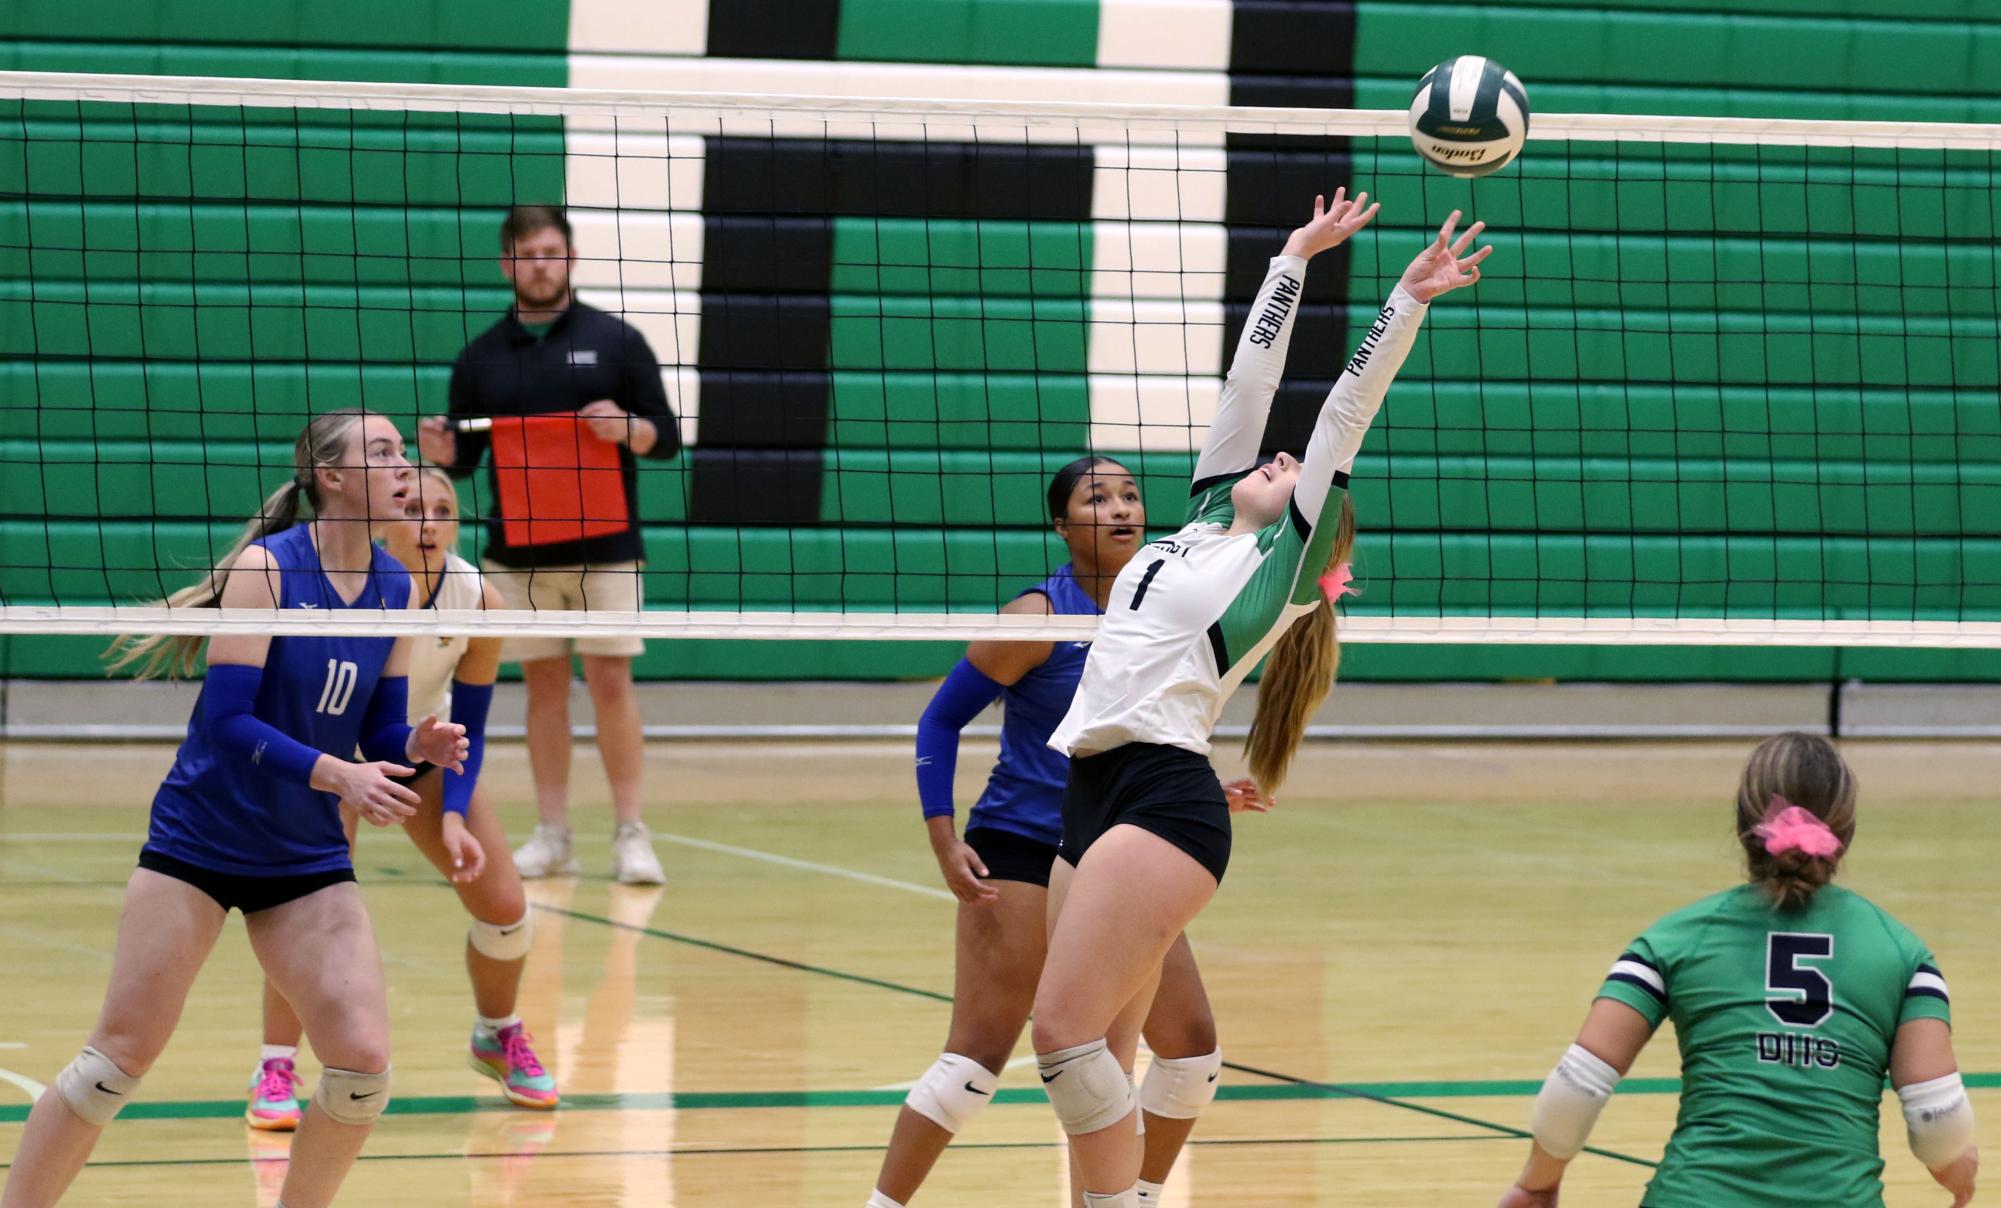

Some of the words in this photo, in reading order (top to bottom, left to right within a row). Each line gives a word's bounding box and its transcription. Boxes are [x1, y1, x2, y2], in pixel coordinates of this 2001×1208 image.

[1249, 274, 1301, 350] PANTHERS
[1346, 305, 1395, 377] PANTHERS
[1129, 558, 1166, 611] 1
[316, 658, 359, 716] 10
[1765, 931, 1834, 1028] 5
